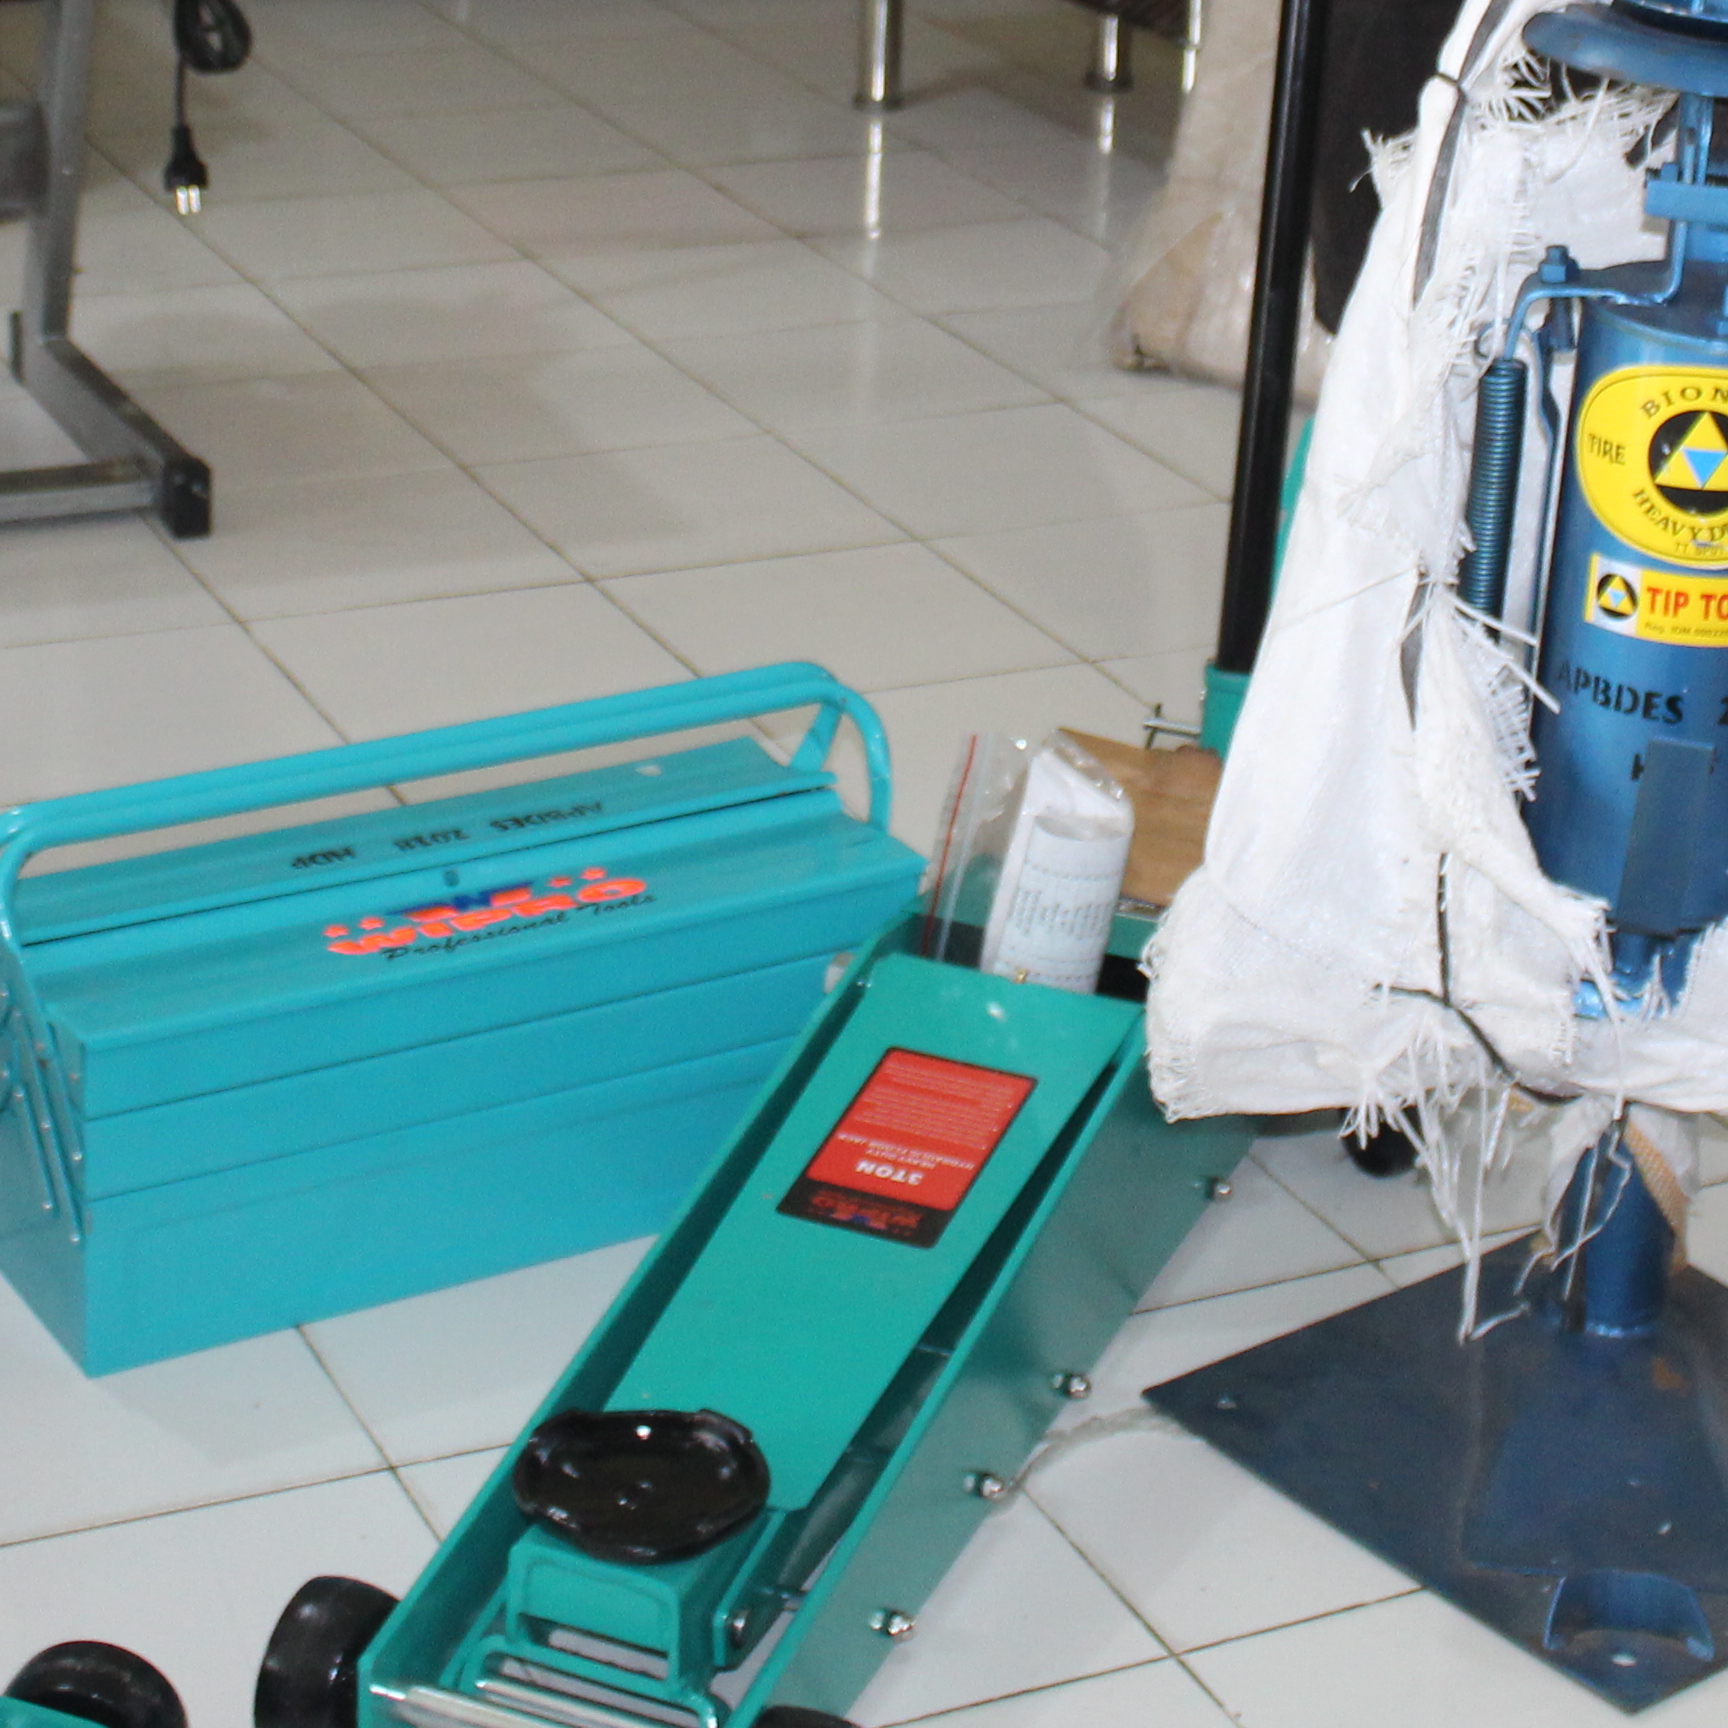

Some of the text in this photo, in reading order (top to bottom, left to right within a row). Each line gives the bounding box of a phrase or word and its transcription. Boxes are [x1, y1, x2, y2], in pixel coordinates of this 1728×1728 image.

[1588, 432, 1626, 466] TIRE
[1632, 488, 1701, 542] HEAVY
[1647, 586, 1691, 619] TIP
[1558, 660, 1684, 725] APBDES
[855, 1160, 924, 1185] 3TON
